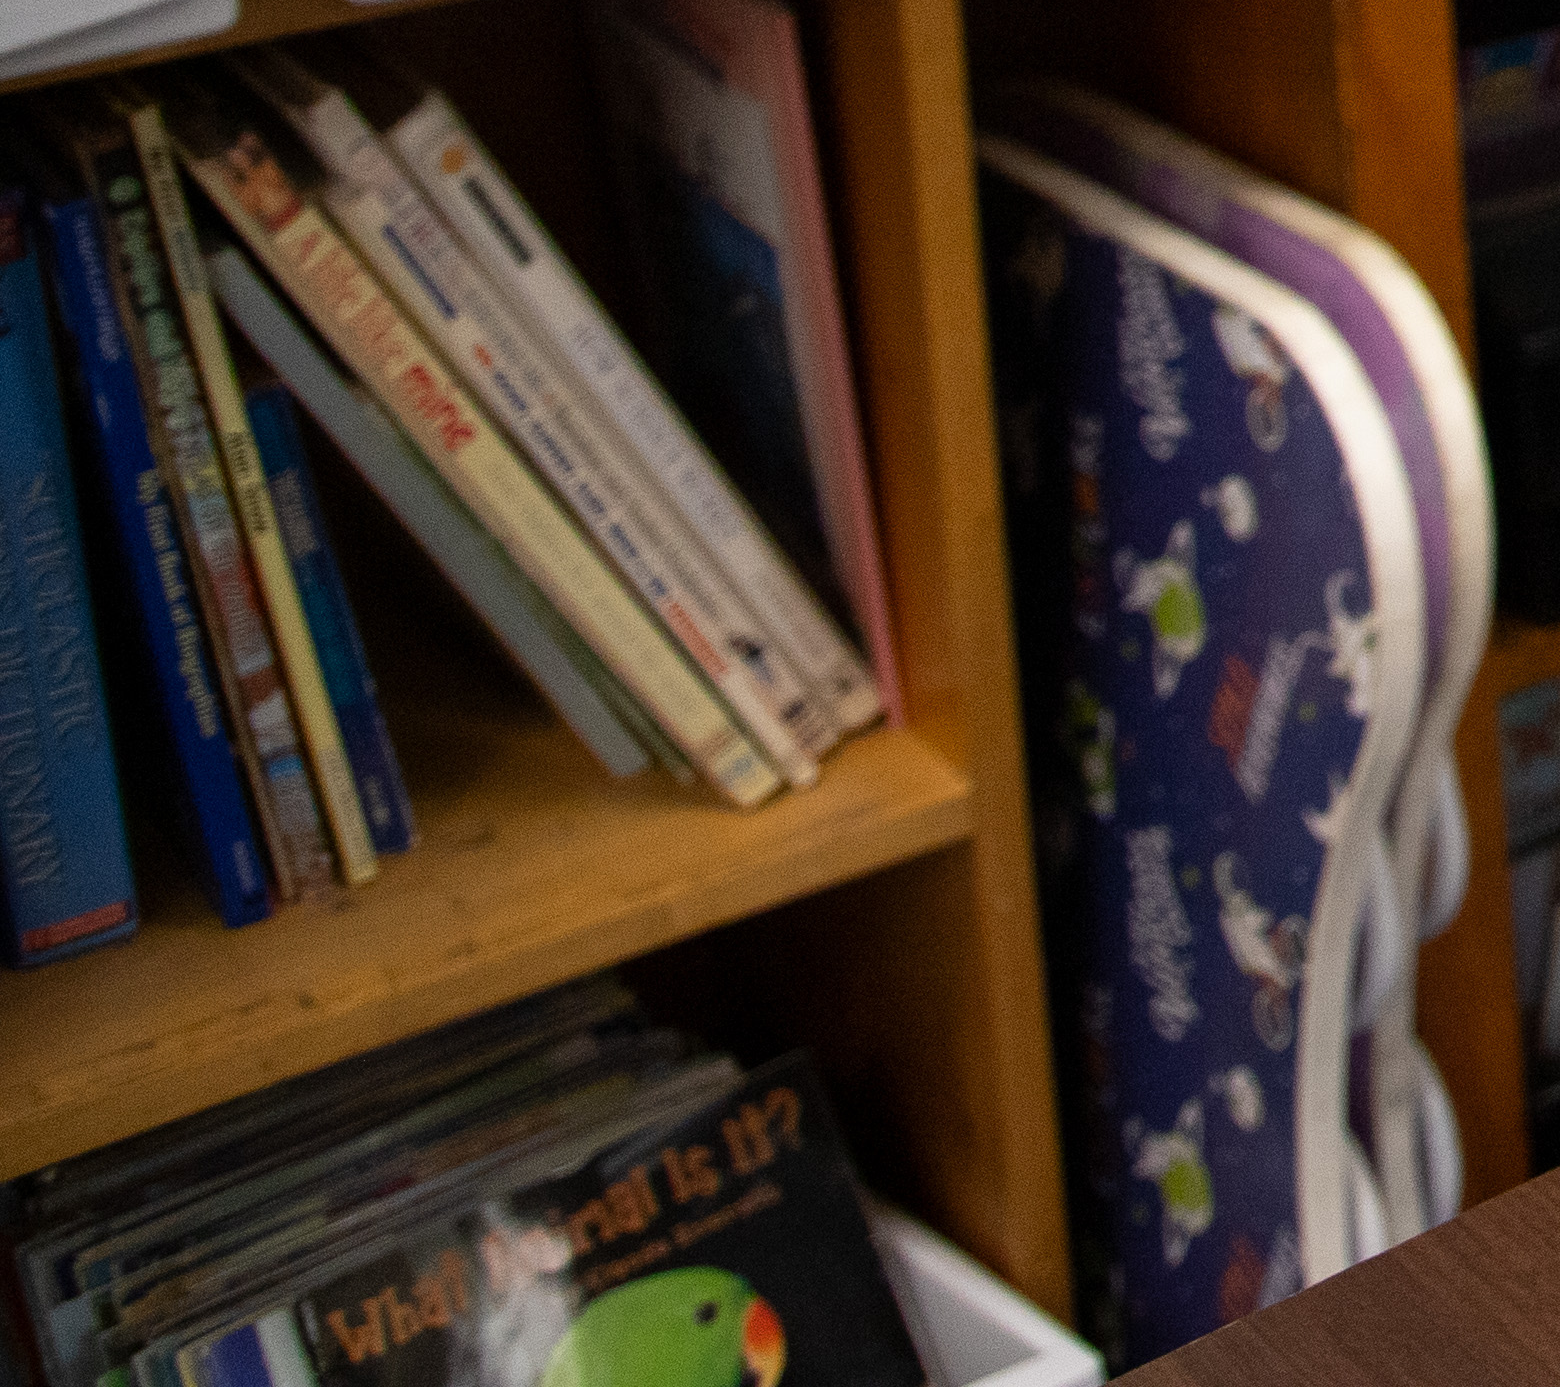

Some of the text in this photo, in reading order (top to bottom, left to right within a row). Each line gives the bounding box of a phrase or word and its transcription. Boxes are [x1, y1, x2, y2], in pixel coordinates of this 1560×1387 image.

[327, 1249, 467, 1365] What
[660, 1143, 722, 1206] Is
[722, 1085, 802, 1177] It?
